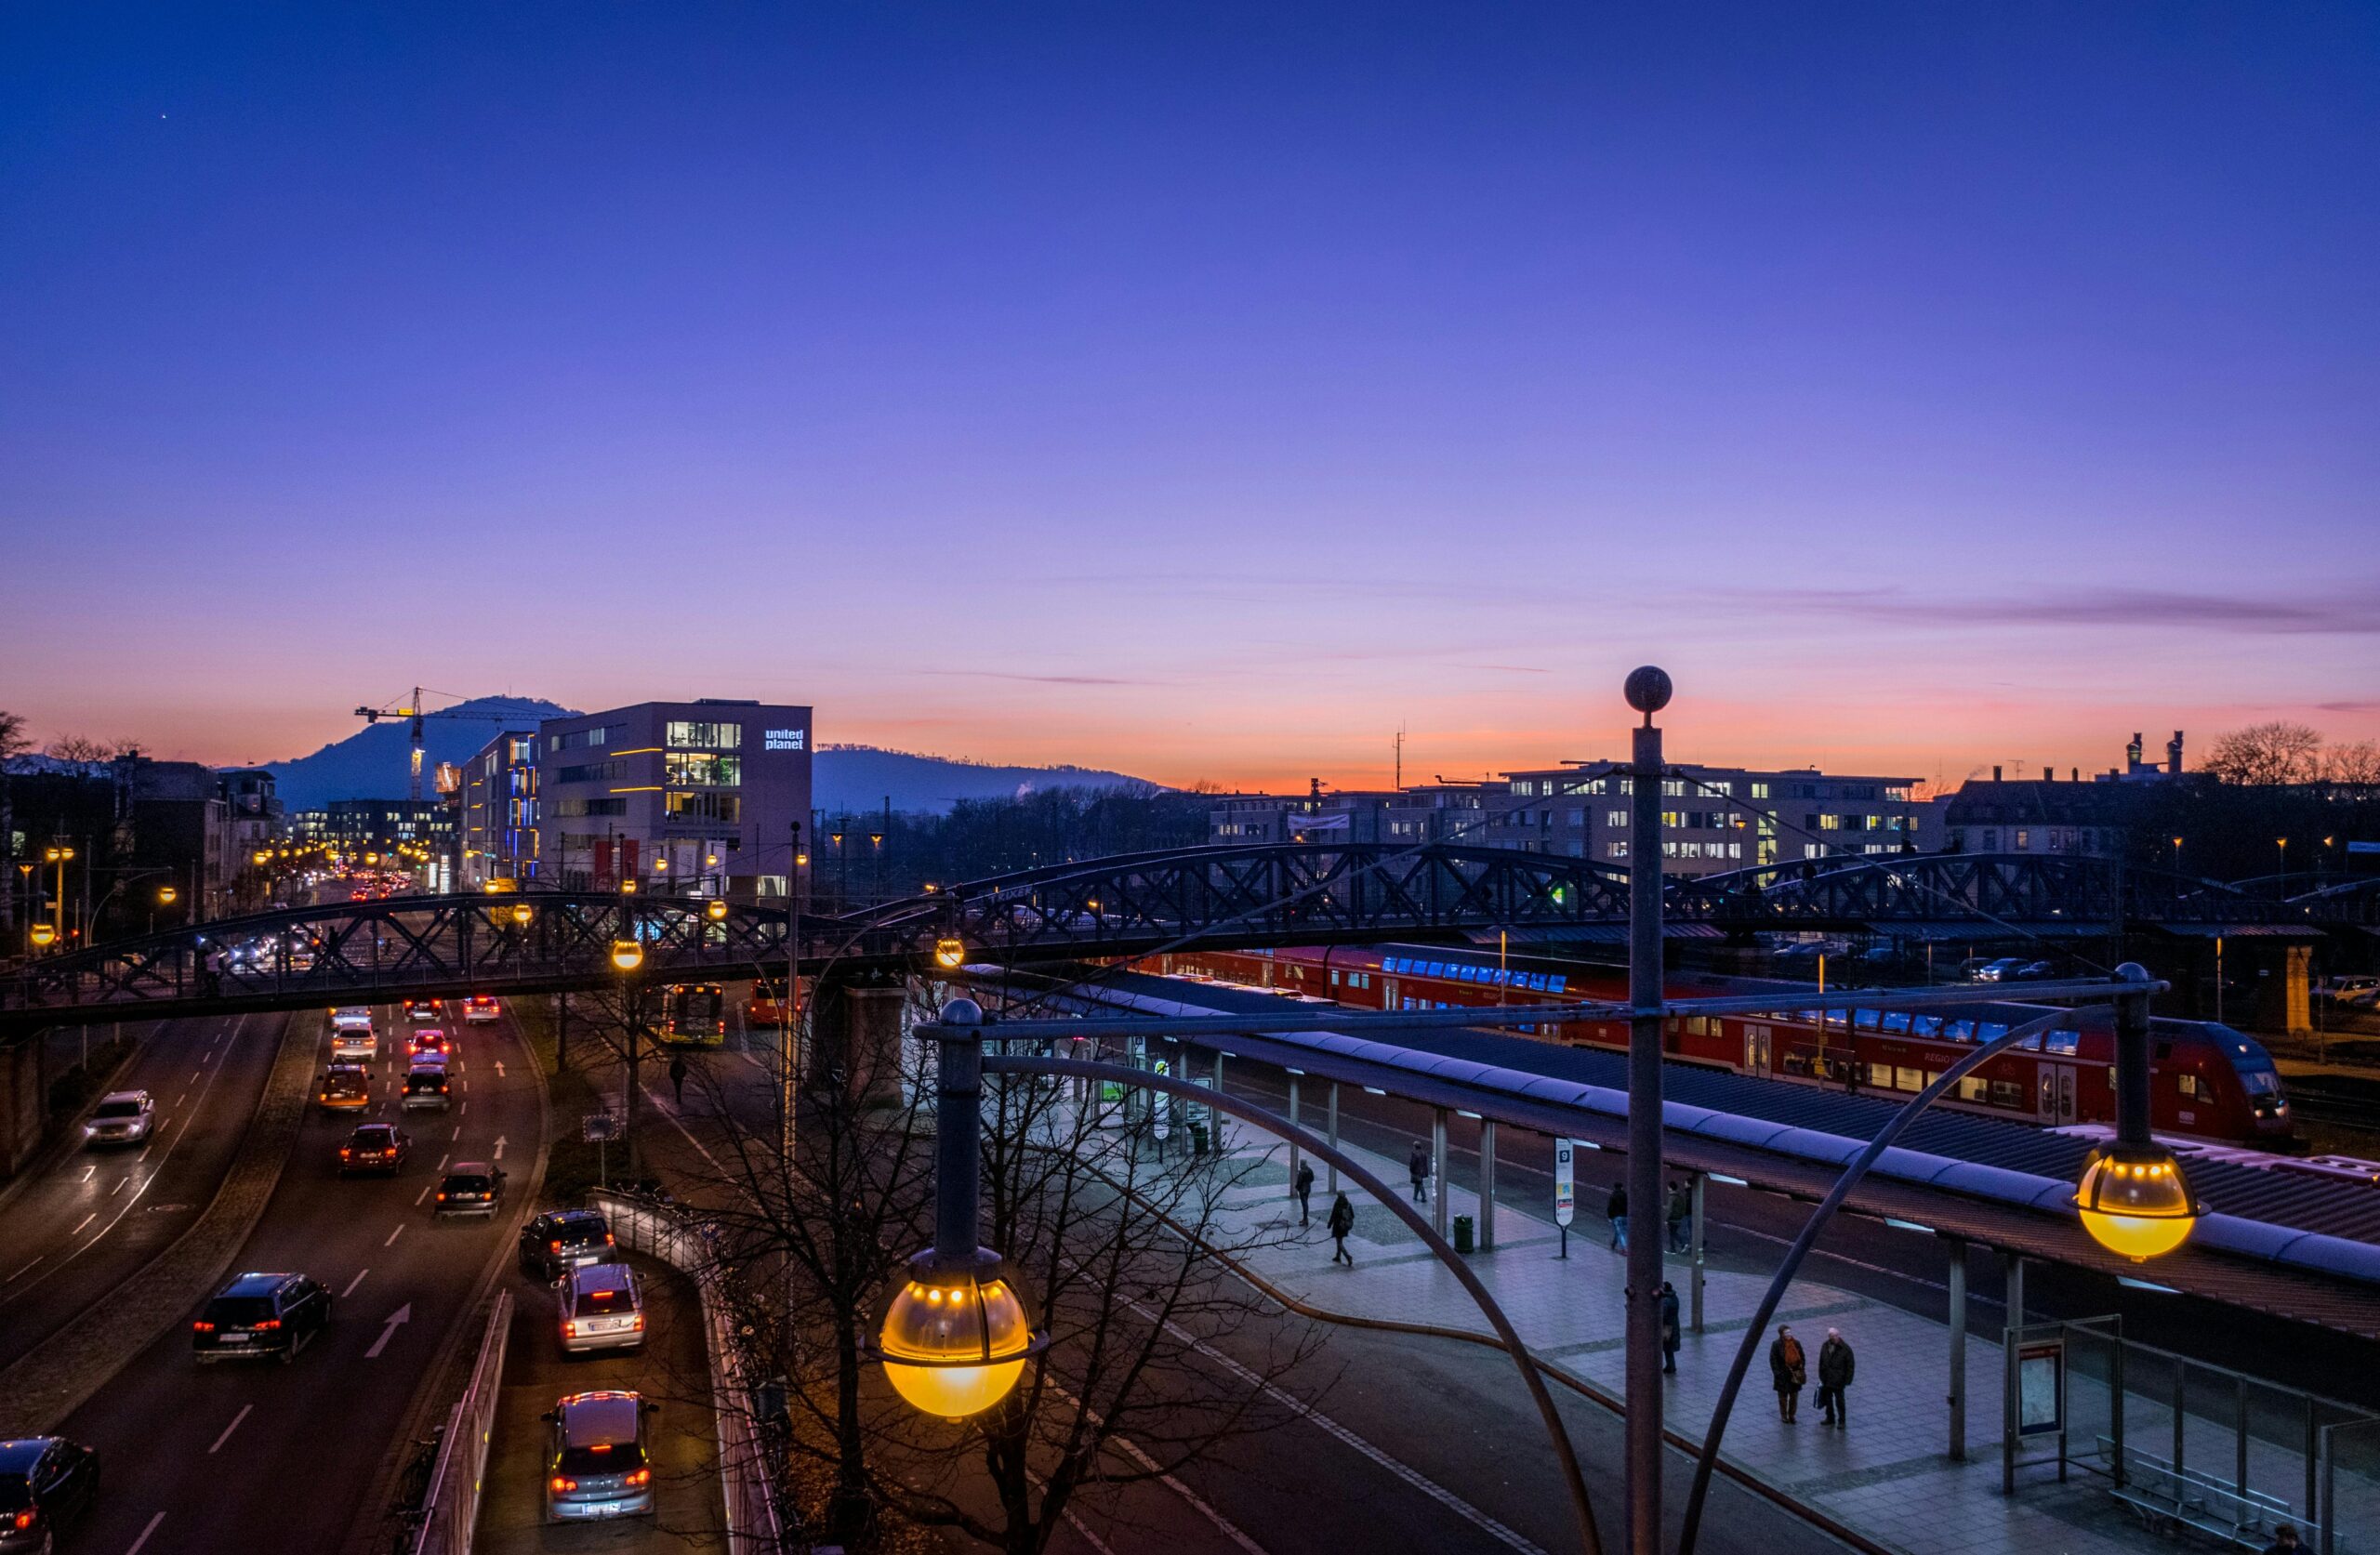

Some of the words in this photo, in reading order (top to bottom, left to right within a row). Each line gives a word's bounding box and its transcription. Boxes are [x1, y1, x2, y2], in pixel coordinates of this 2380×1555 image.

[765, 729, 803, 740] united
[765, 739, 803, 750] planet
[1924, 1052, 1950, 1064] REGIO
[1561, 1151, 1568, 1161] 9
